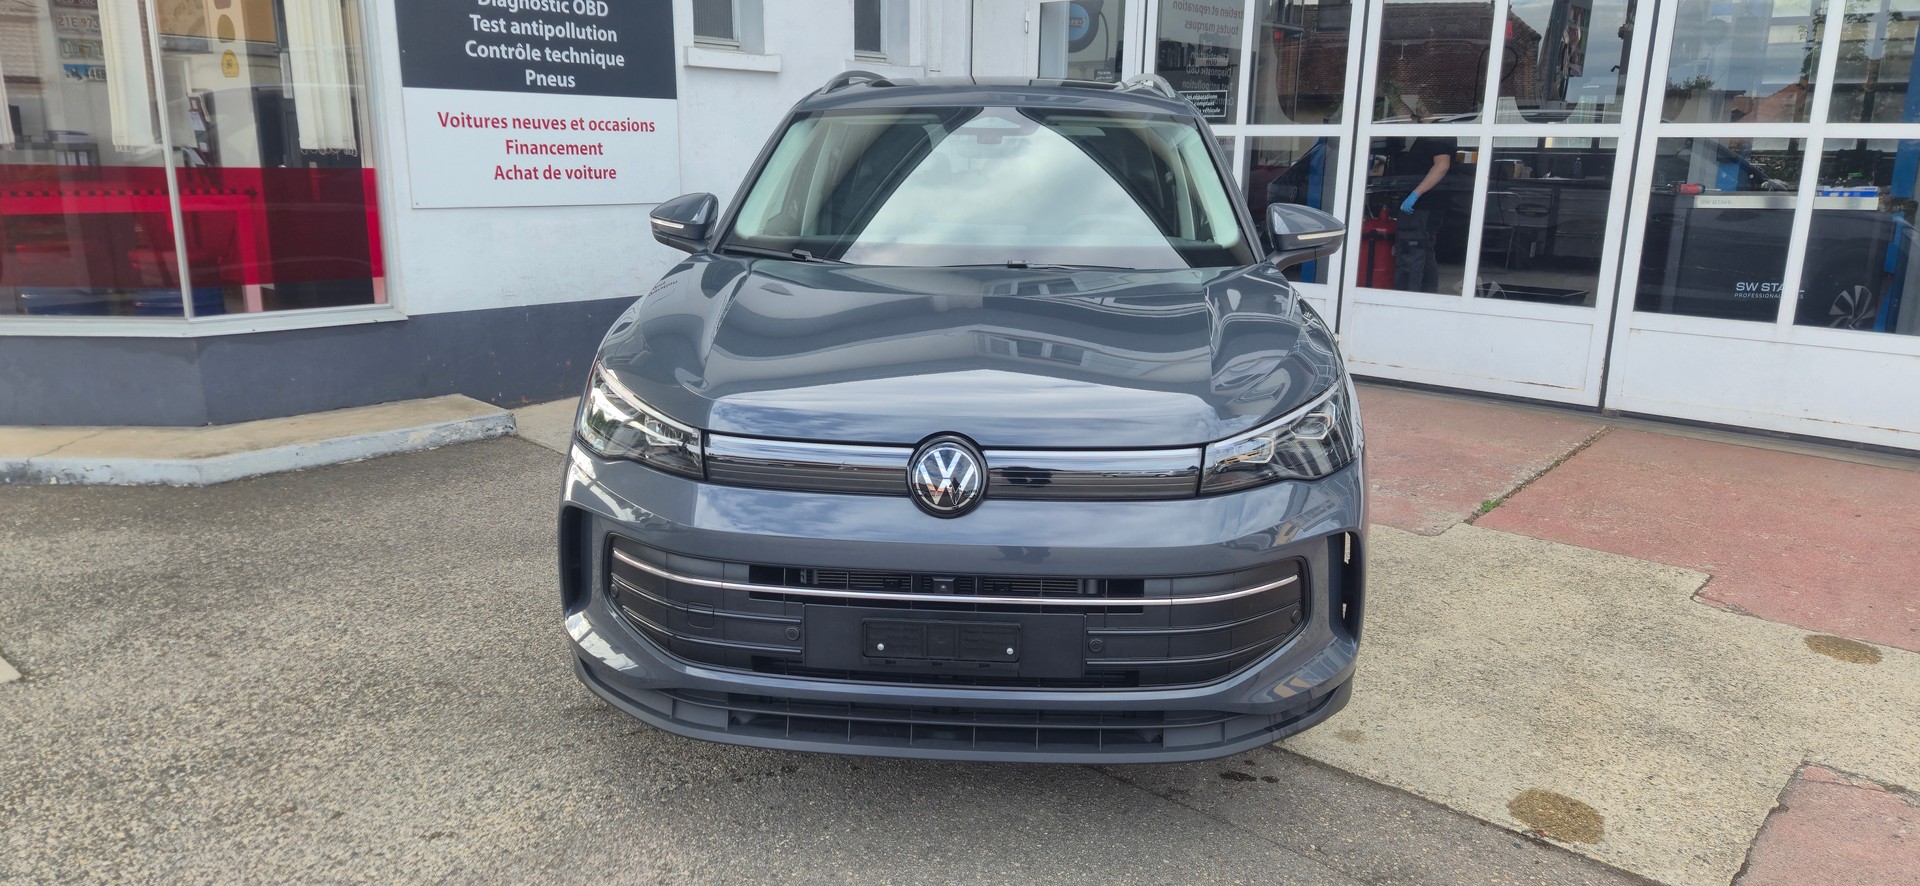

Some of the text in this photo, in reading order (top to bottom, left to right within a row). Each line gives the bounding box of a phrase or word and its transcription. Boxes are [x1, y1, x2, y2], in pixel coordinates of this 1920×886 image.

[573, 0, 609, 17] OBD
[469, 14, 617, 42] Test antipollution
[465, 40, 625, 69] Contrôle technique
[525, 69, 576, 88] Pneus
[437, 111, 656, 133] Voitures neuves et occasions
[505, 139, 604, 155] Financement
[494, 164, 617, 180] Achat de voiture
[1736, 282, 1760, 291] SW
